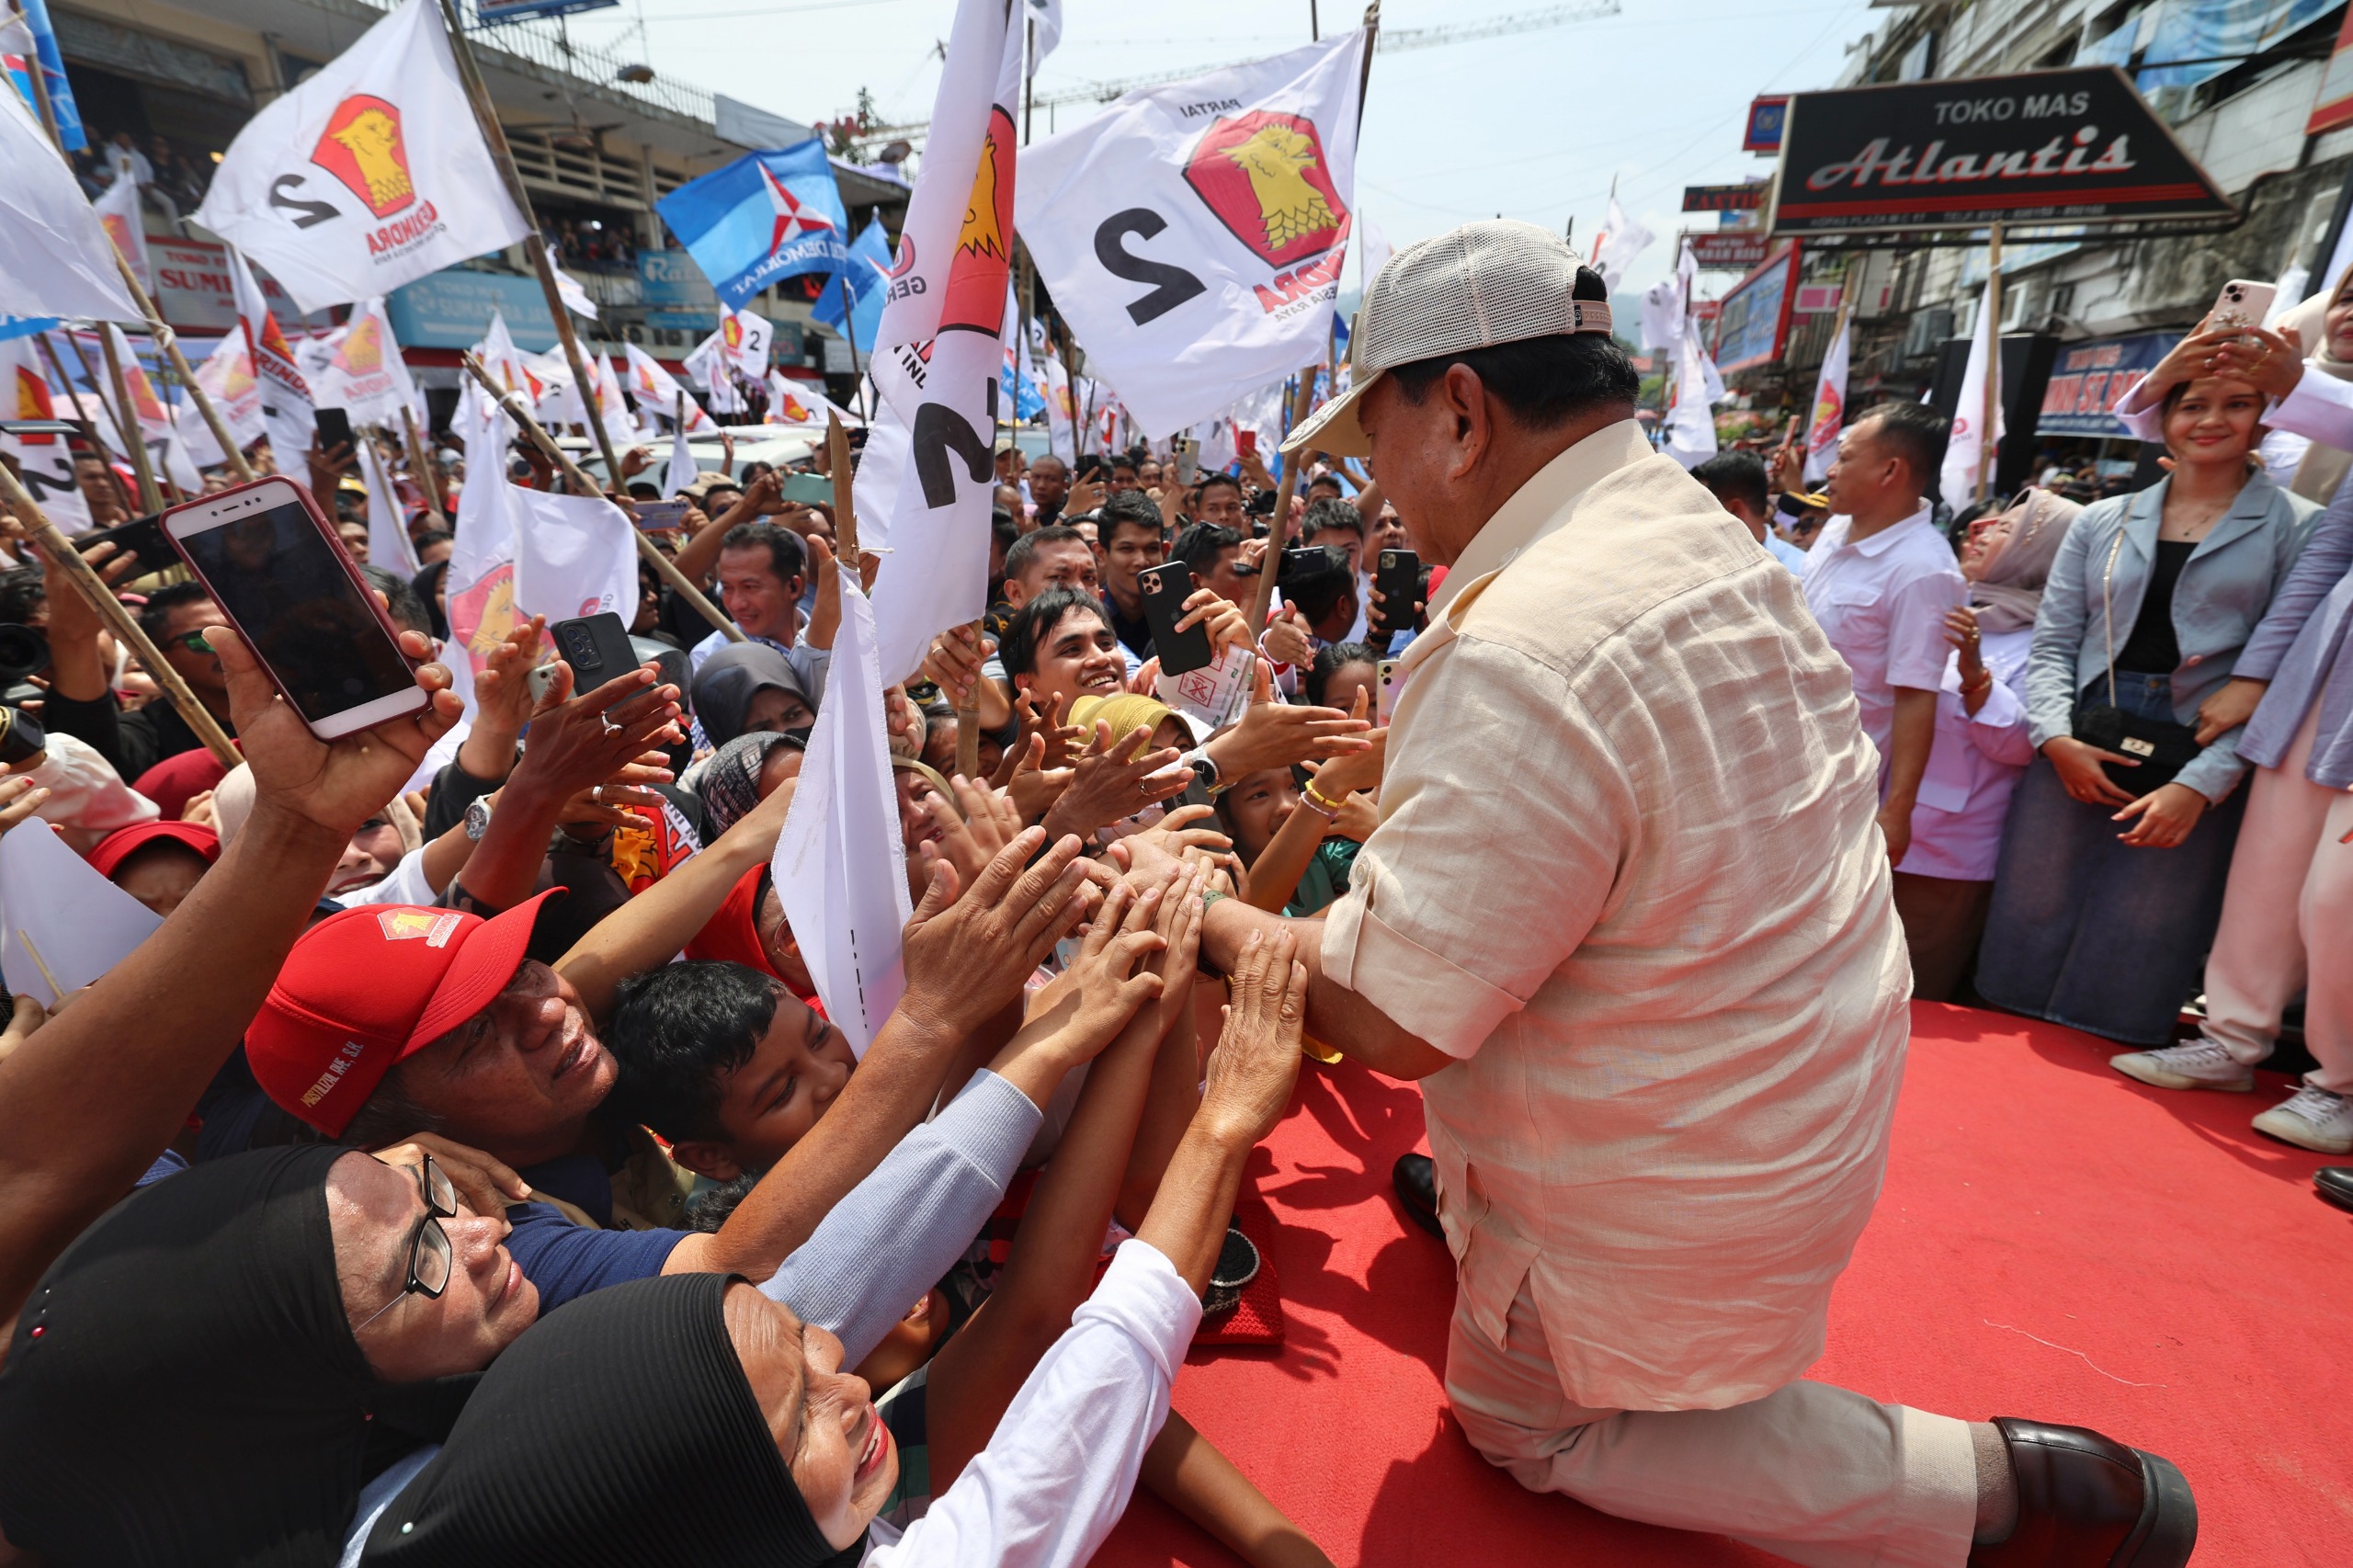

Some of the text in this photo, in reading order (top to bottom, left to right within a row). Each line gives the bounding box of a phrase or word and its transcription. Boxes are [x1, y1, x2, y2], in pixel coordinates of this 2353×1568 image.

[1934, 92, 2089, 125] TOKO MAS
[1805, 125, 2138, 192] Atlantis
[749, 331, 759, 351] 2
